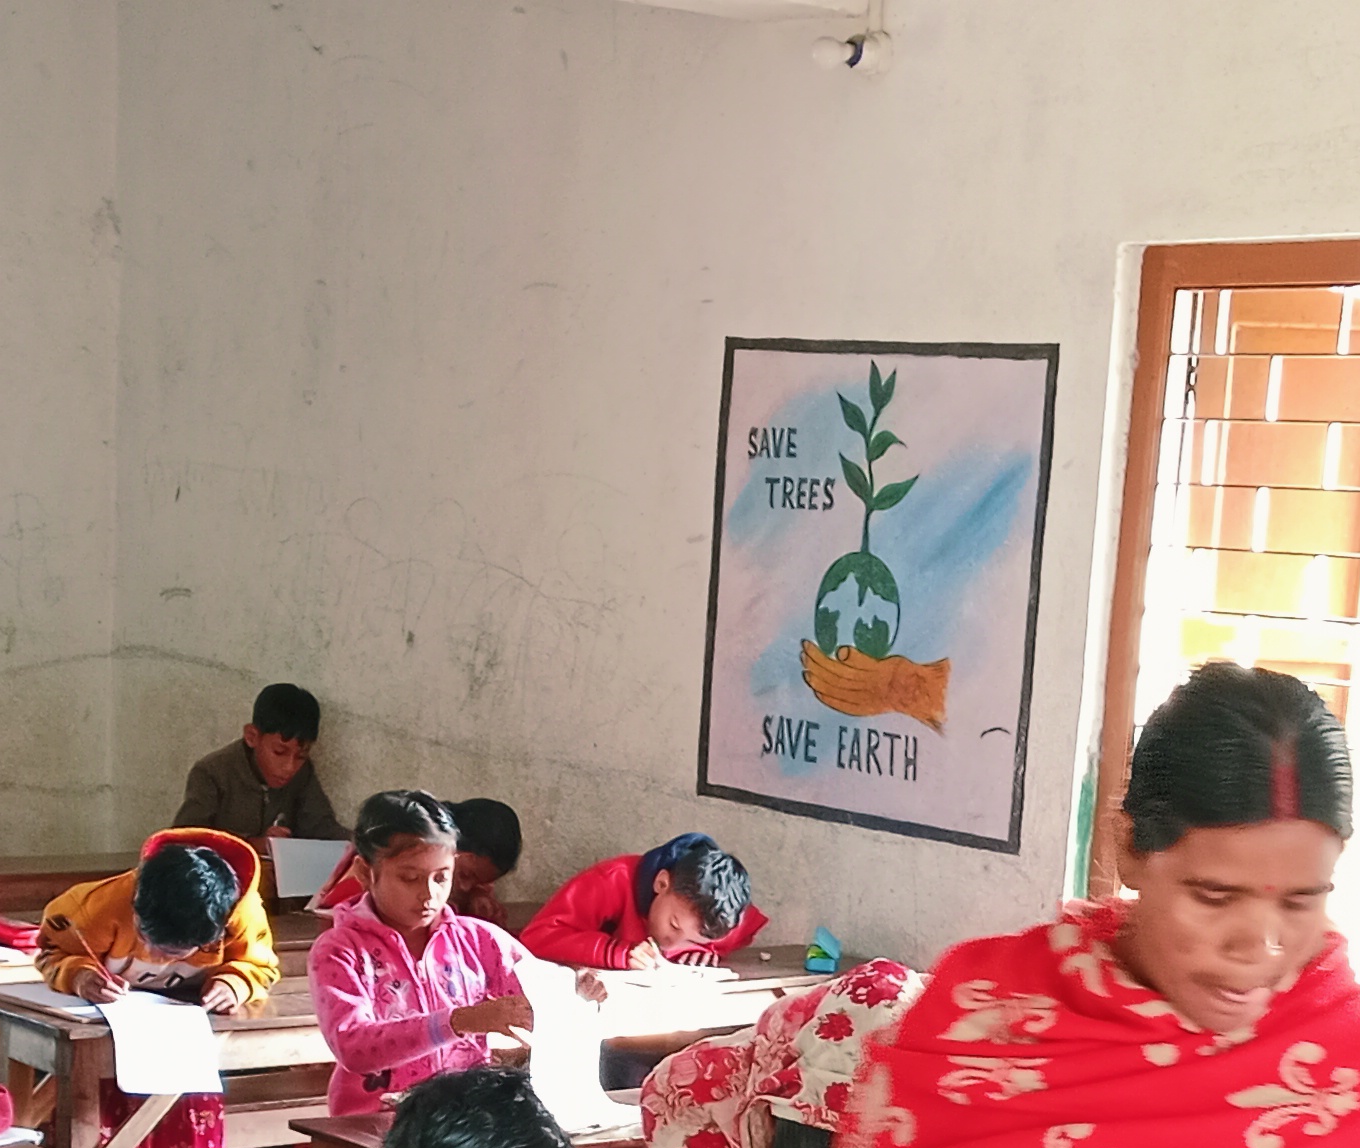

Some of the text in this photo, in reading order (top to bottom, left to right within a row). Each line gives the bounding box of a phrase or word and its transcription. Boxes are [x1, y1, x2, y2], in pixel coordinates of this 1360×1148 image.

[747, 426, 798, 459] SAVE
[764, 475, 837, 512] TREES
[761, 713, 919, 782] SAVE EARTH
